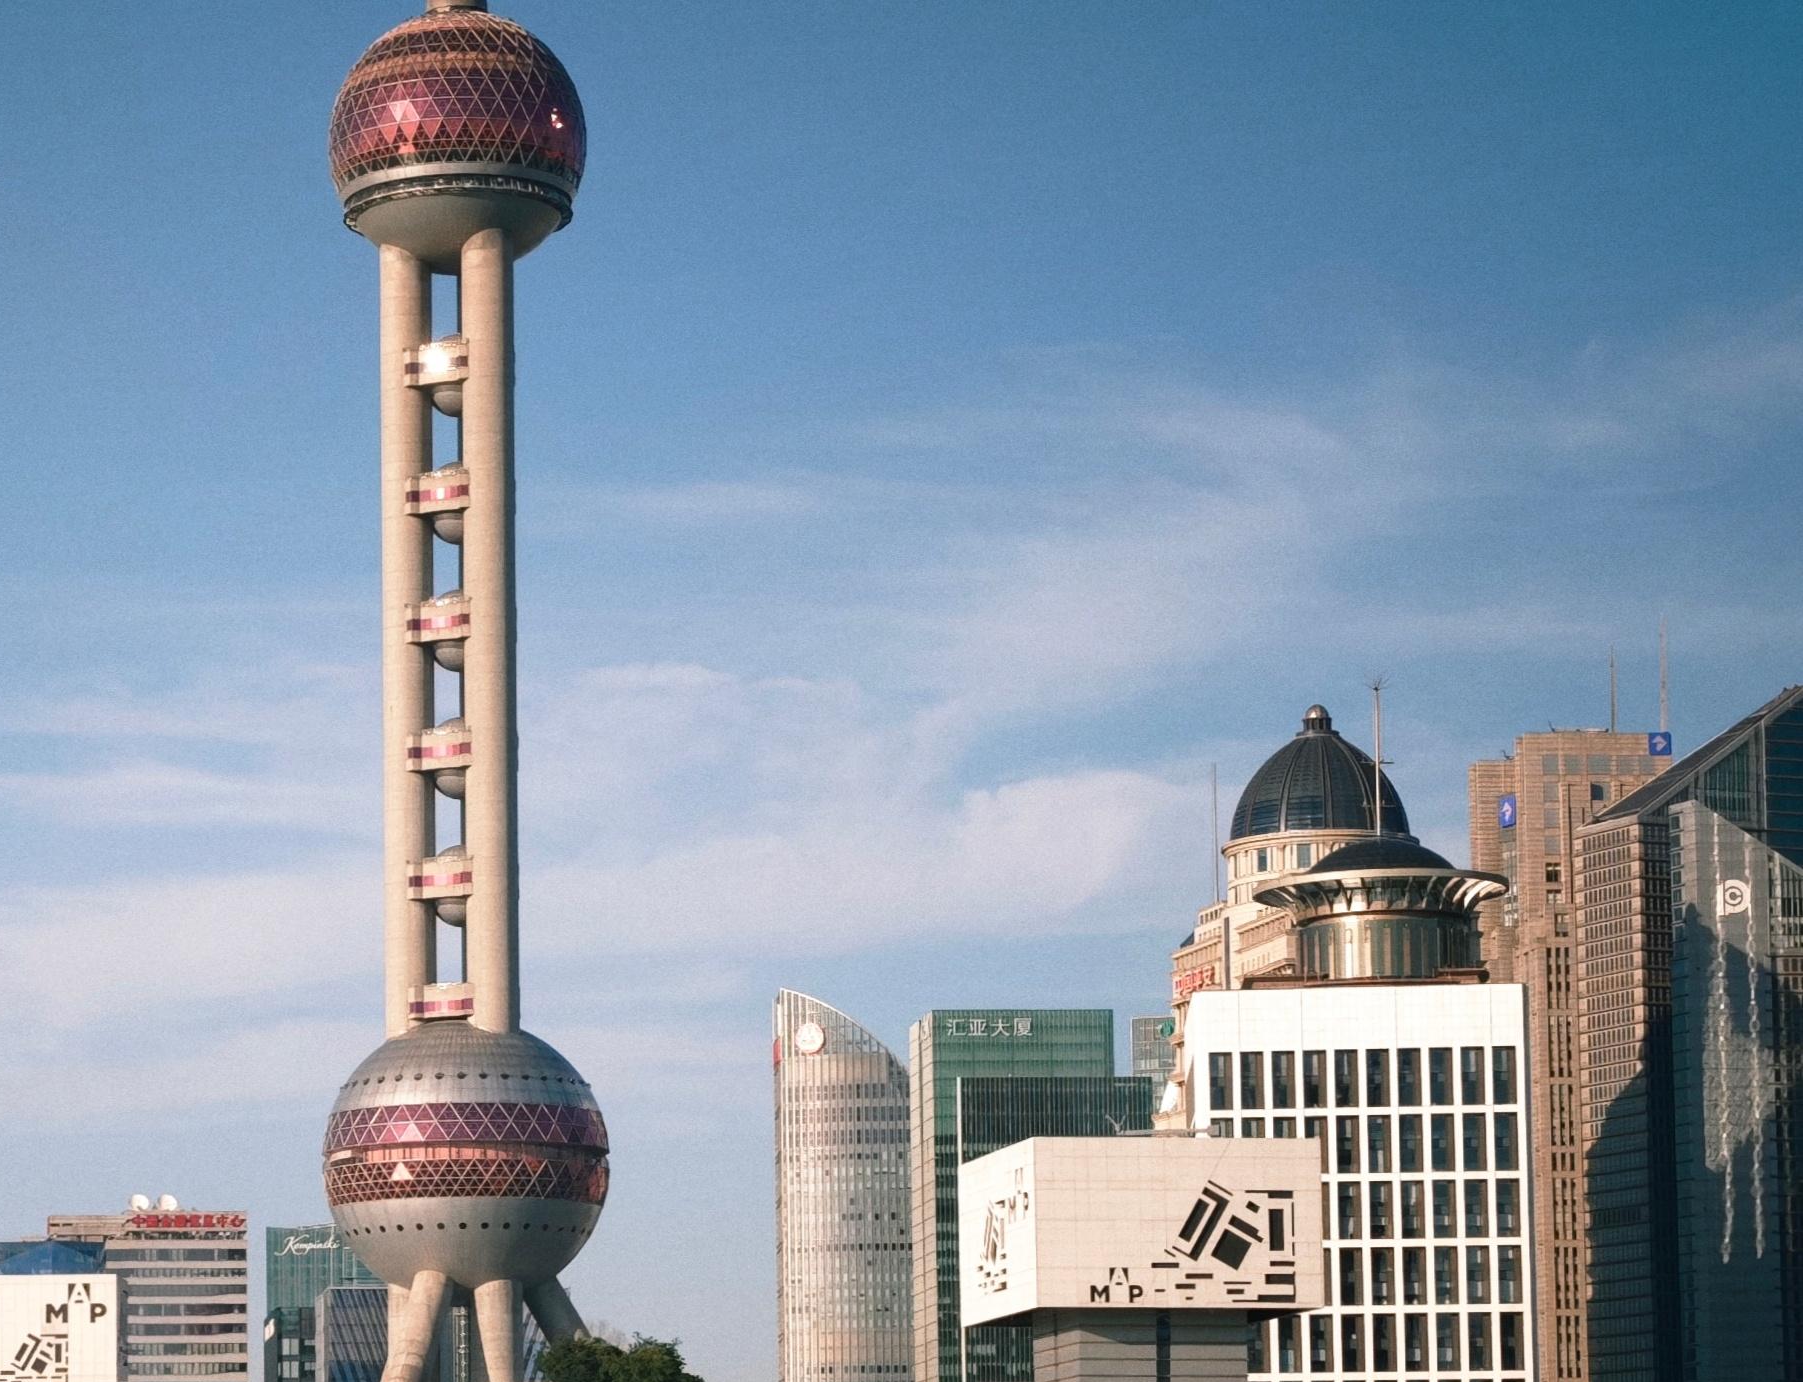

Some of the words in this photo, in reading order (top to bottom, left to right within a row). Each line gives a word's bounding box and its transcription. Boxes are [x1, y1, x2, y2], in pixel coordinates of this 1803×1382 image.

[946, 1017, 1033, 1037] 汇亚大厦
[274, 1234, 340, 1256] Kempinski
[1090, 1266, 1144, 1303] MAP
[45, 1282, 108, 1324] MAP
